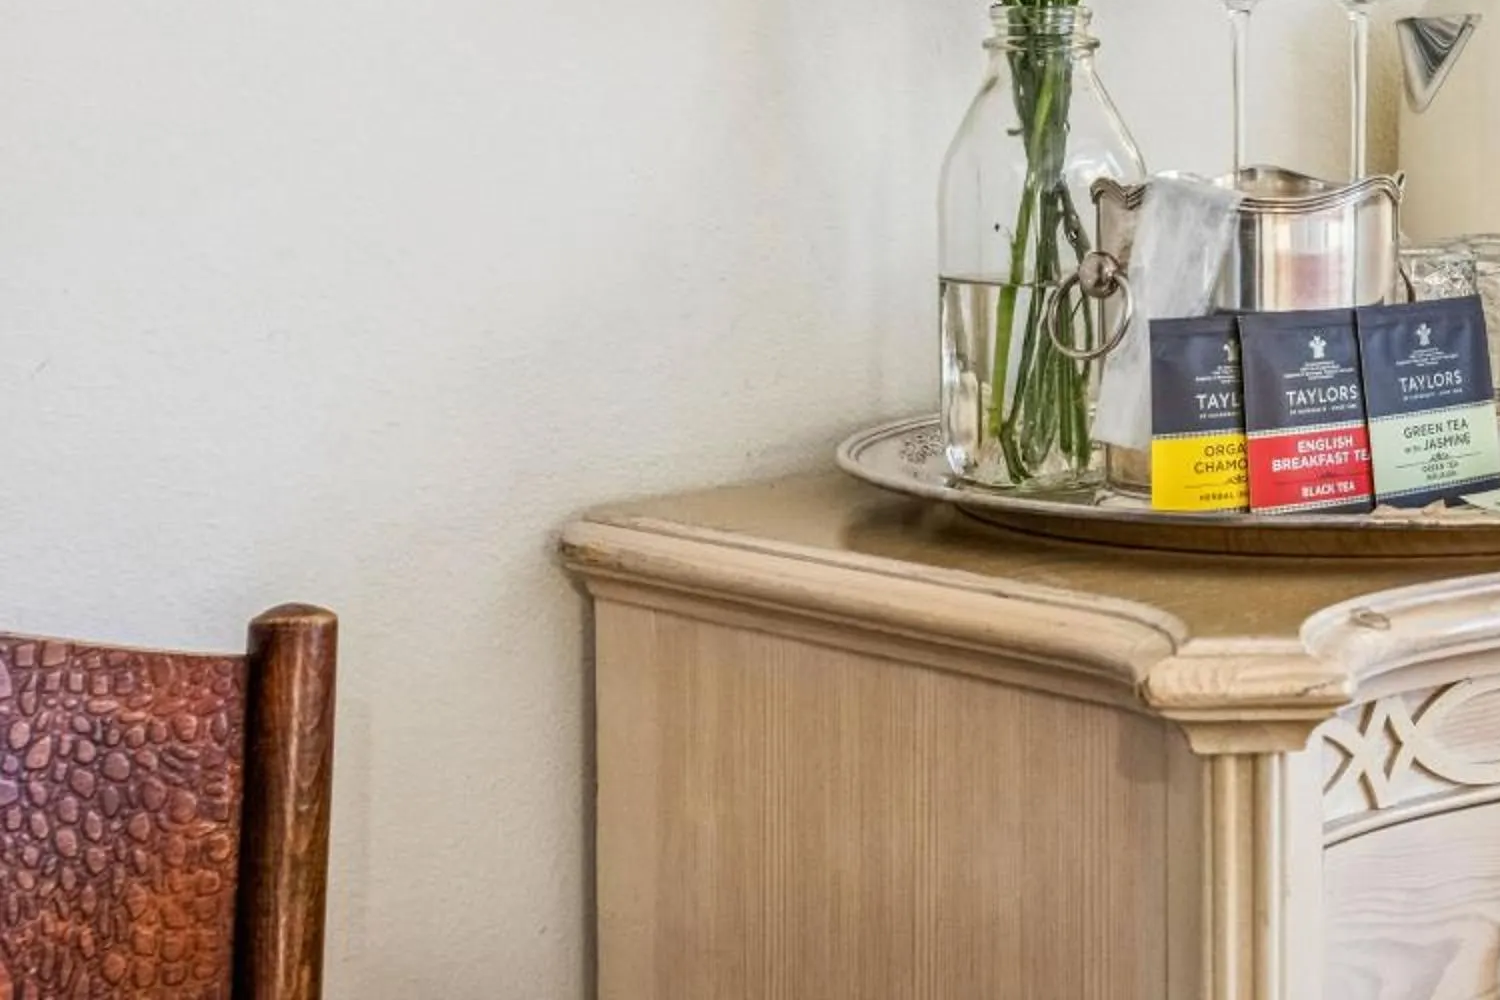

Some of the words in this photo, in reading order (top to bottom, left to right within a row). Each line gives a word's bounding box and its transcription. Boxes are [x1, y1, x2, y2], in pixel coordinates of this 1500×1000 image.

[1398, 368, 1463, 393] TAYLORS
[1285, 383, 1359, 407] TAYLORS
[1403, 423, 1443, 440] GREEN
[1446, 417, 1469, 432] TEA
[1297, 434, 1354, 454] ENGLISH
[1423, 431, 1471, 452] JASMINE
[1271, 451, 1350, 473] BREAKFAST
[1301, 484, 1335, 498] BLACK
[1337, 480, 1356, 494] TEA
